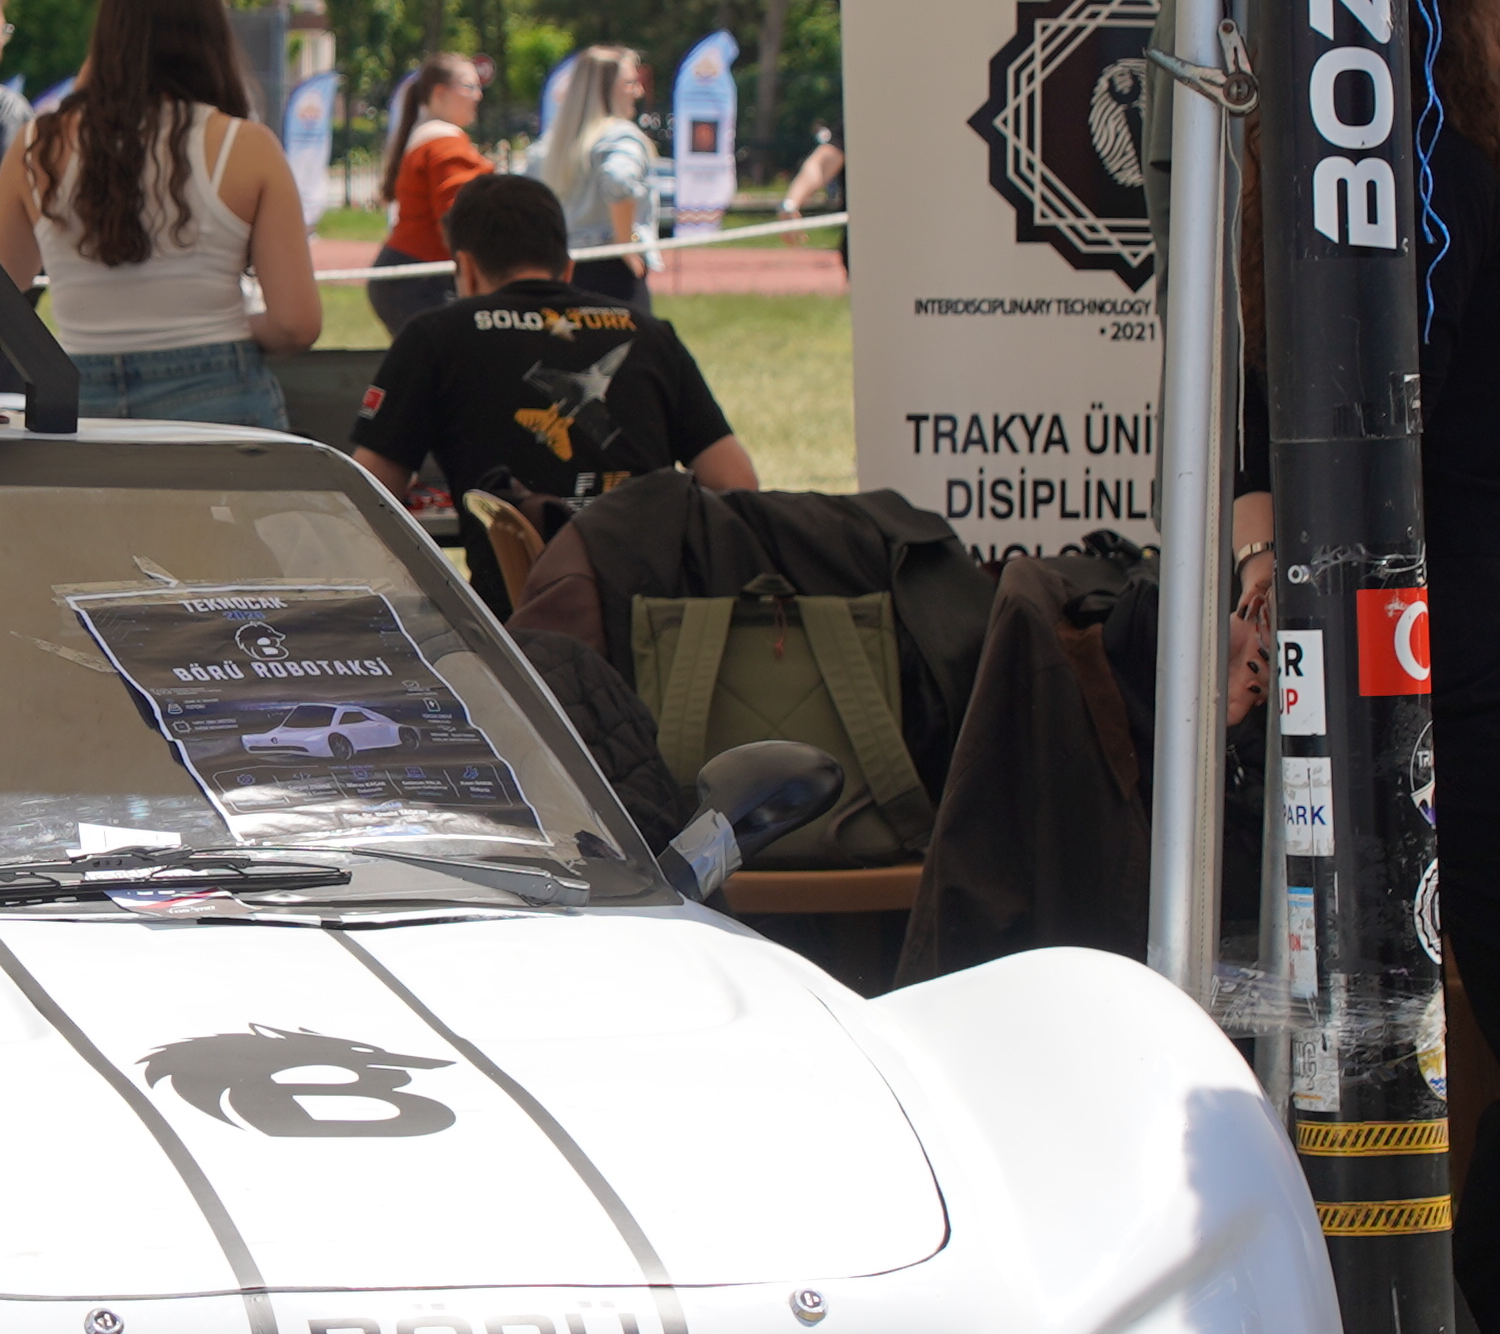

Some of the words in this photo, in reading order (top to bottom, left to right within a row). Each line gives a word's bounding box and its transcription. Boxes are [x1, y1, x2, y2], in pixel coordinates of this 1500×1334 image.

[914, 299, 1051, 316] INTERDISCIPLINARY
[1056, 299, 1152, 315] TECHNOLOGY
[474, 309, 544, 331] SOLO
[1110, 322, 1156, 341] 2021
[906, 413, 1070, 455] TRAKYA
[1085, 401, 1152, 455] ÜNİ
[946, 467, 1155, 520] DİSİPLİNL
[178, 595, 289, 614] TEKNOCAK
[173, 660, 245, 682] BÖRÜ
[251, 656, 393, 679] ROBOTAKSİ
